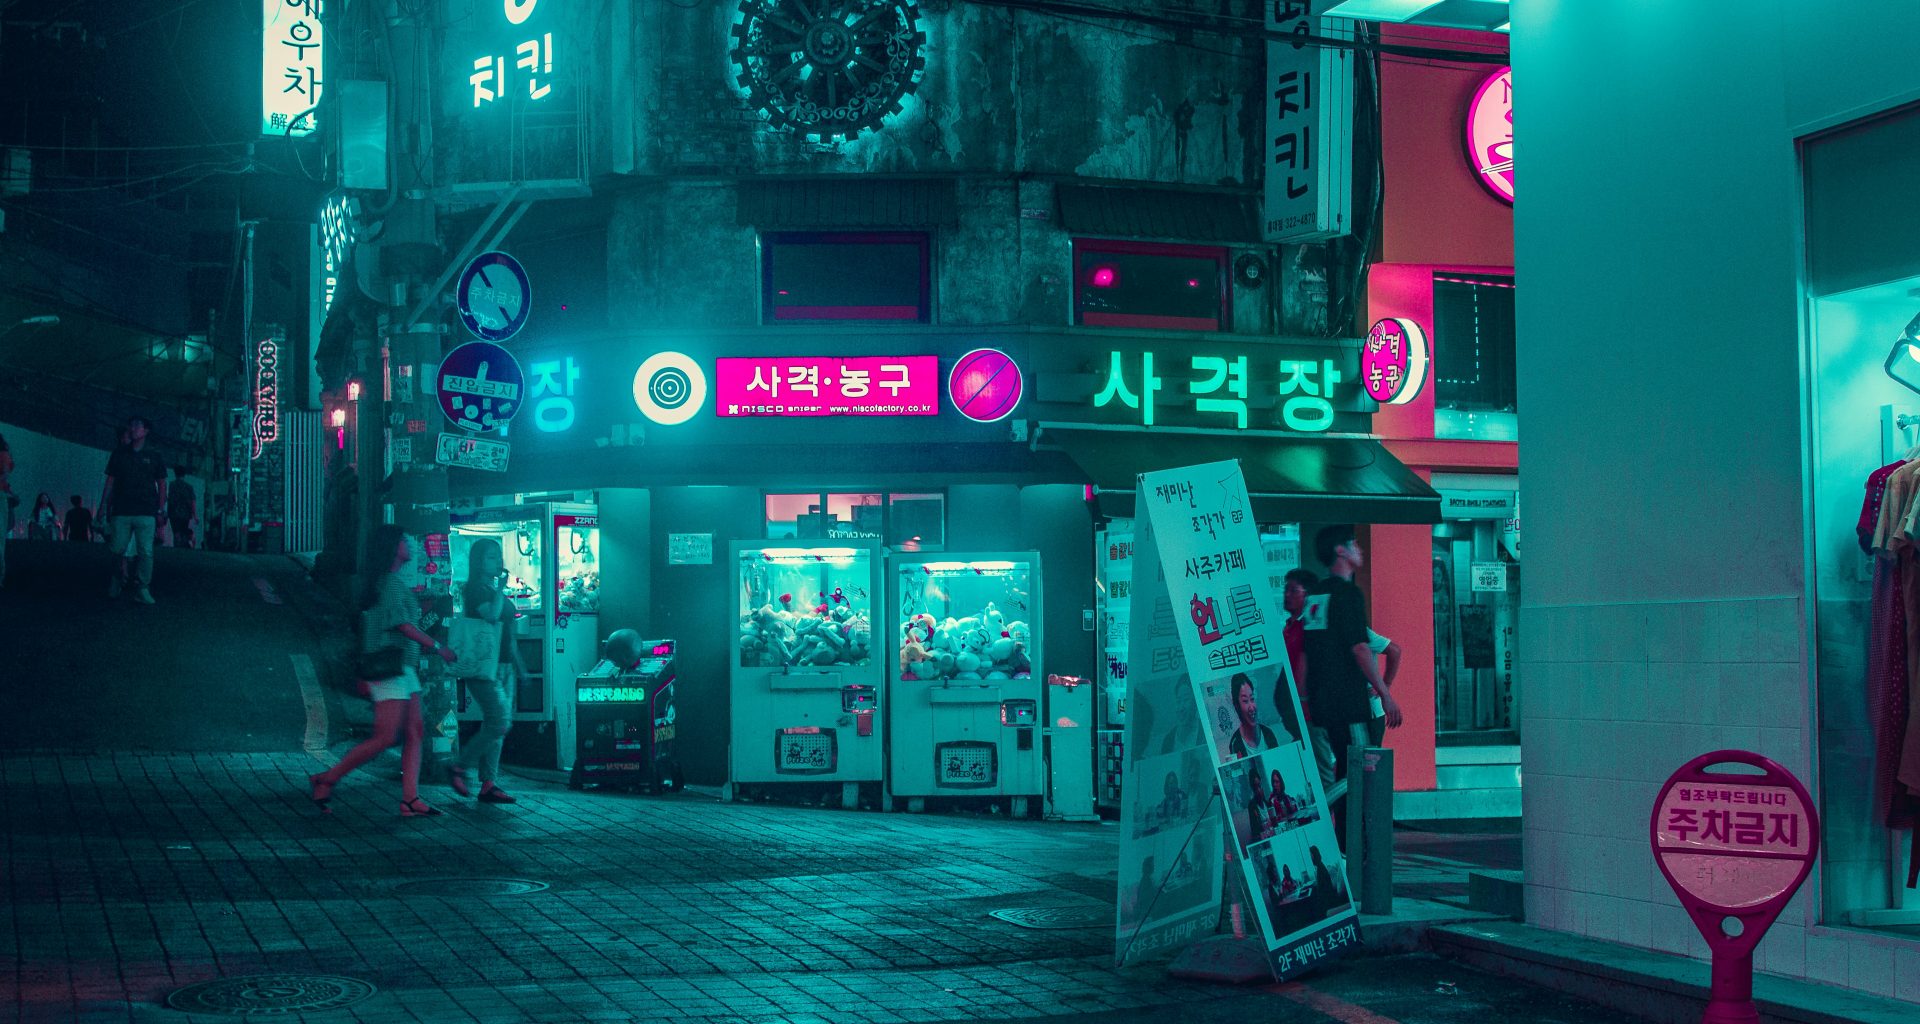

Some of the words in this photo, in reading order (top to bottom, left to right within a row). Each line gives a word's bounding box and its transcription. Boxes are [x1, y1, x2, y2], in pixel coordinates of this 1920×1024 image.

[469, 32, 552, 107] 치킨
[471, 287, 520, 308] 주차금지
[1370, 332, 1400, 360] 사격
[1369, 361, 1399, 391] 농구
[530, 356, 580, 433] 장
[1093, 351, 1342, 432] 사격장
[829, 404, 931, 414] www.niscofactory.co.kr
[1155, 481, 1197, 509] 재미난
[1191, 511, 1226, 541] 조각가
[1231, 509, 1244, 525] 2F
[1185, 549, 1247, 580] 사주카페
[1478, 576, 1498, 586] 영업중
[1208, 634, 1269, 671] 슬램덩크
[578, 687, 645, 702] DESPERADO
[1679, 788, 1787, 807] 협조부탁드립니다
[1668, 808, 1798, 848] 주차금지
[1279, 952, 1293, 973] 2F
[1293, 937, 1327, 966] 재미난
[1326, 924, 1357, 950] 조각가
